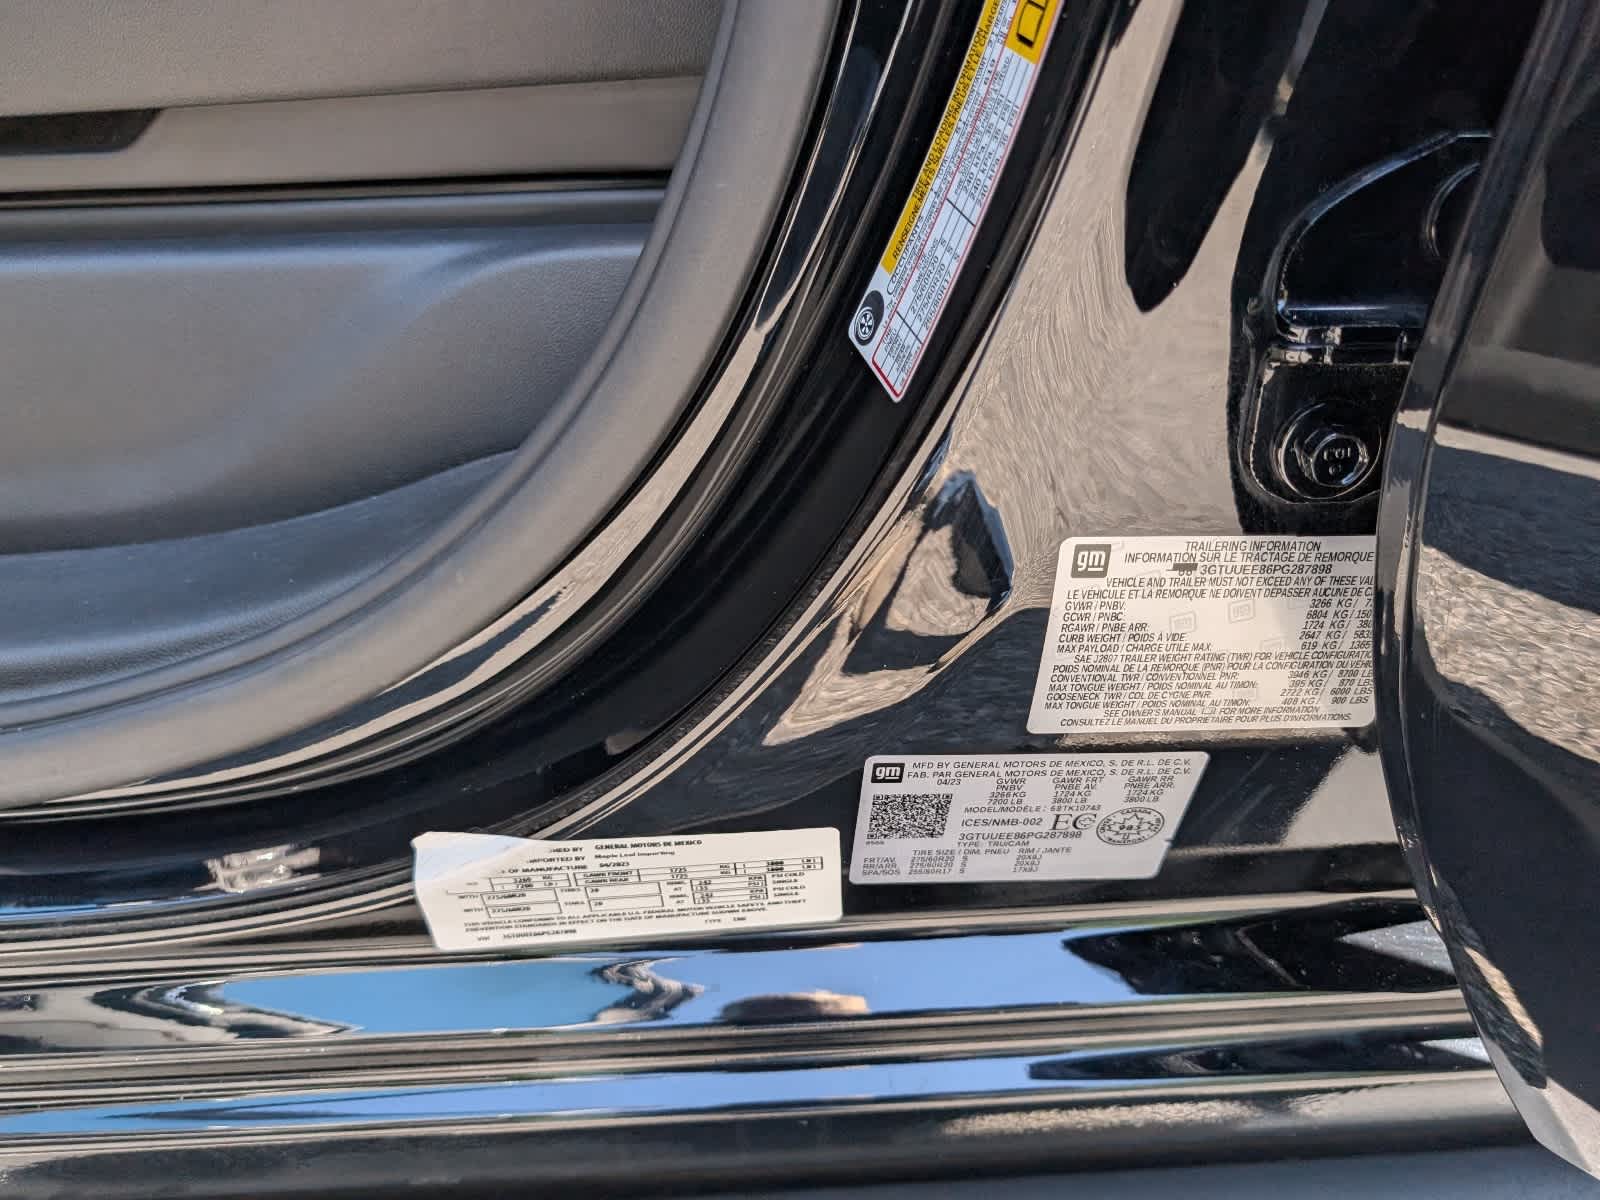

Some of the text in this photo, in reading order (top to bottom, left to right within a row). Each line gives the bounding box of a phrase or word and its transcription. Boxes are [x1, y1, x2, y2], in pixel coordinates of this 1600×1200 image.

[923, 153, 935, 174] AND
[931, 103, 955, 153] LOADING
[951, 27, 985, 102] INFORMATION
[892, 168, 936, 258] RENSEIGNEMENTS
[942, 121, 955, 143] LES
[951, 84, 969, 120] PNEUS
[891, 216, 924, 284] OCCUPANTS
[1186, 541, 1322, 552] TRAILERING INFORMATION
[1077, 551, 1106, 572] gm
[1125, 552, 1375, 564] INFORMATION SUR LE TRACTAGE DE REMORQUE
[1201, 564, 1333, 575] 3GTUUEE86PG287898
[1107, 578, 1145, 587] VEHICLE
[1147, 578, 1166, 587] AND
[1170, 576, 1208, 587] TRAILER
[1209, 577, 1234, 586] MUST
[1236, 577, 1254, 586] NOT
[1256, 577, 1292, 586] EXCEED
[1294, 577, 1312, 585] ANY
[1314, 576, 1326, 585] OF
[1329, 576, 1358, 585] THESE
[1067, 590, 1079, 599] LE
[1082, 587, 1126, 599] VÉHICULE
[1128, 590, 1139, 599] ET
[1142, 589, 1153, 599] LA
[1156, 589, 1208, 601] REMORQUE
[1210, 589, 1223, 598] NE
[1223, 589, 1262, 598] DOIVENT
[1312, 588, 1349, 597] AUCUNE
[1351, 588, 1364, 597] DE
[1065, 601, 1093, 610] GVWR
[1310, 599, 1332, 608] 3266
[1063, 613, 1092, 621] GCWR
[1306, 610, 1328, 619] 6804
[1061, 623, 1096, 632] RGAWR
[1101, 623, 1127, 632] PNBE
[1303, 621, 1325, 629] 1724
[1059, 634, 1084, 643] CURB
[1087, 634, 1121, 643] WEIGHT
[1128, 634, 1155, 642] POIDS
[1299, 631, 1322, 640] 2647
[1057, 645, 1077, 654] MAX
[1079, 644, 1120, 653] PAYLOAD
[1128, 644, 1164, 653] CHARGE
[1166, 643, 1190, 652] UTILE
[1301, 642, 1317, 650] 619
[1003, 760, 1047, 768] MOTORS
[875, 766, 901, 780] gm
[1004, 770, 1047, 778] MOTORS
[962, 818, 1043, 827] ICES/NMB-002
[959, 831, 1082, 841] 3GTUUEE86PG287898
